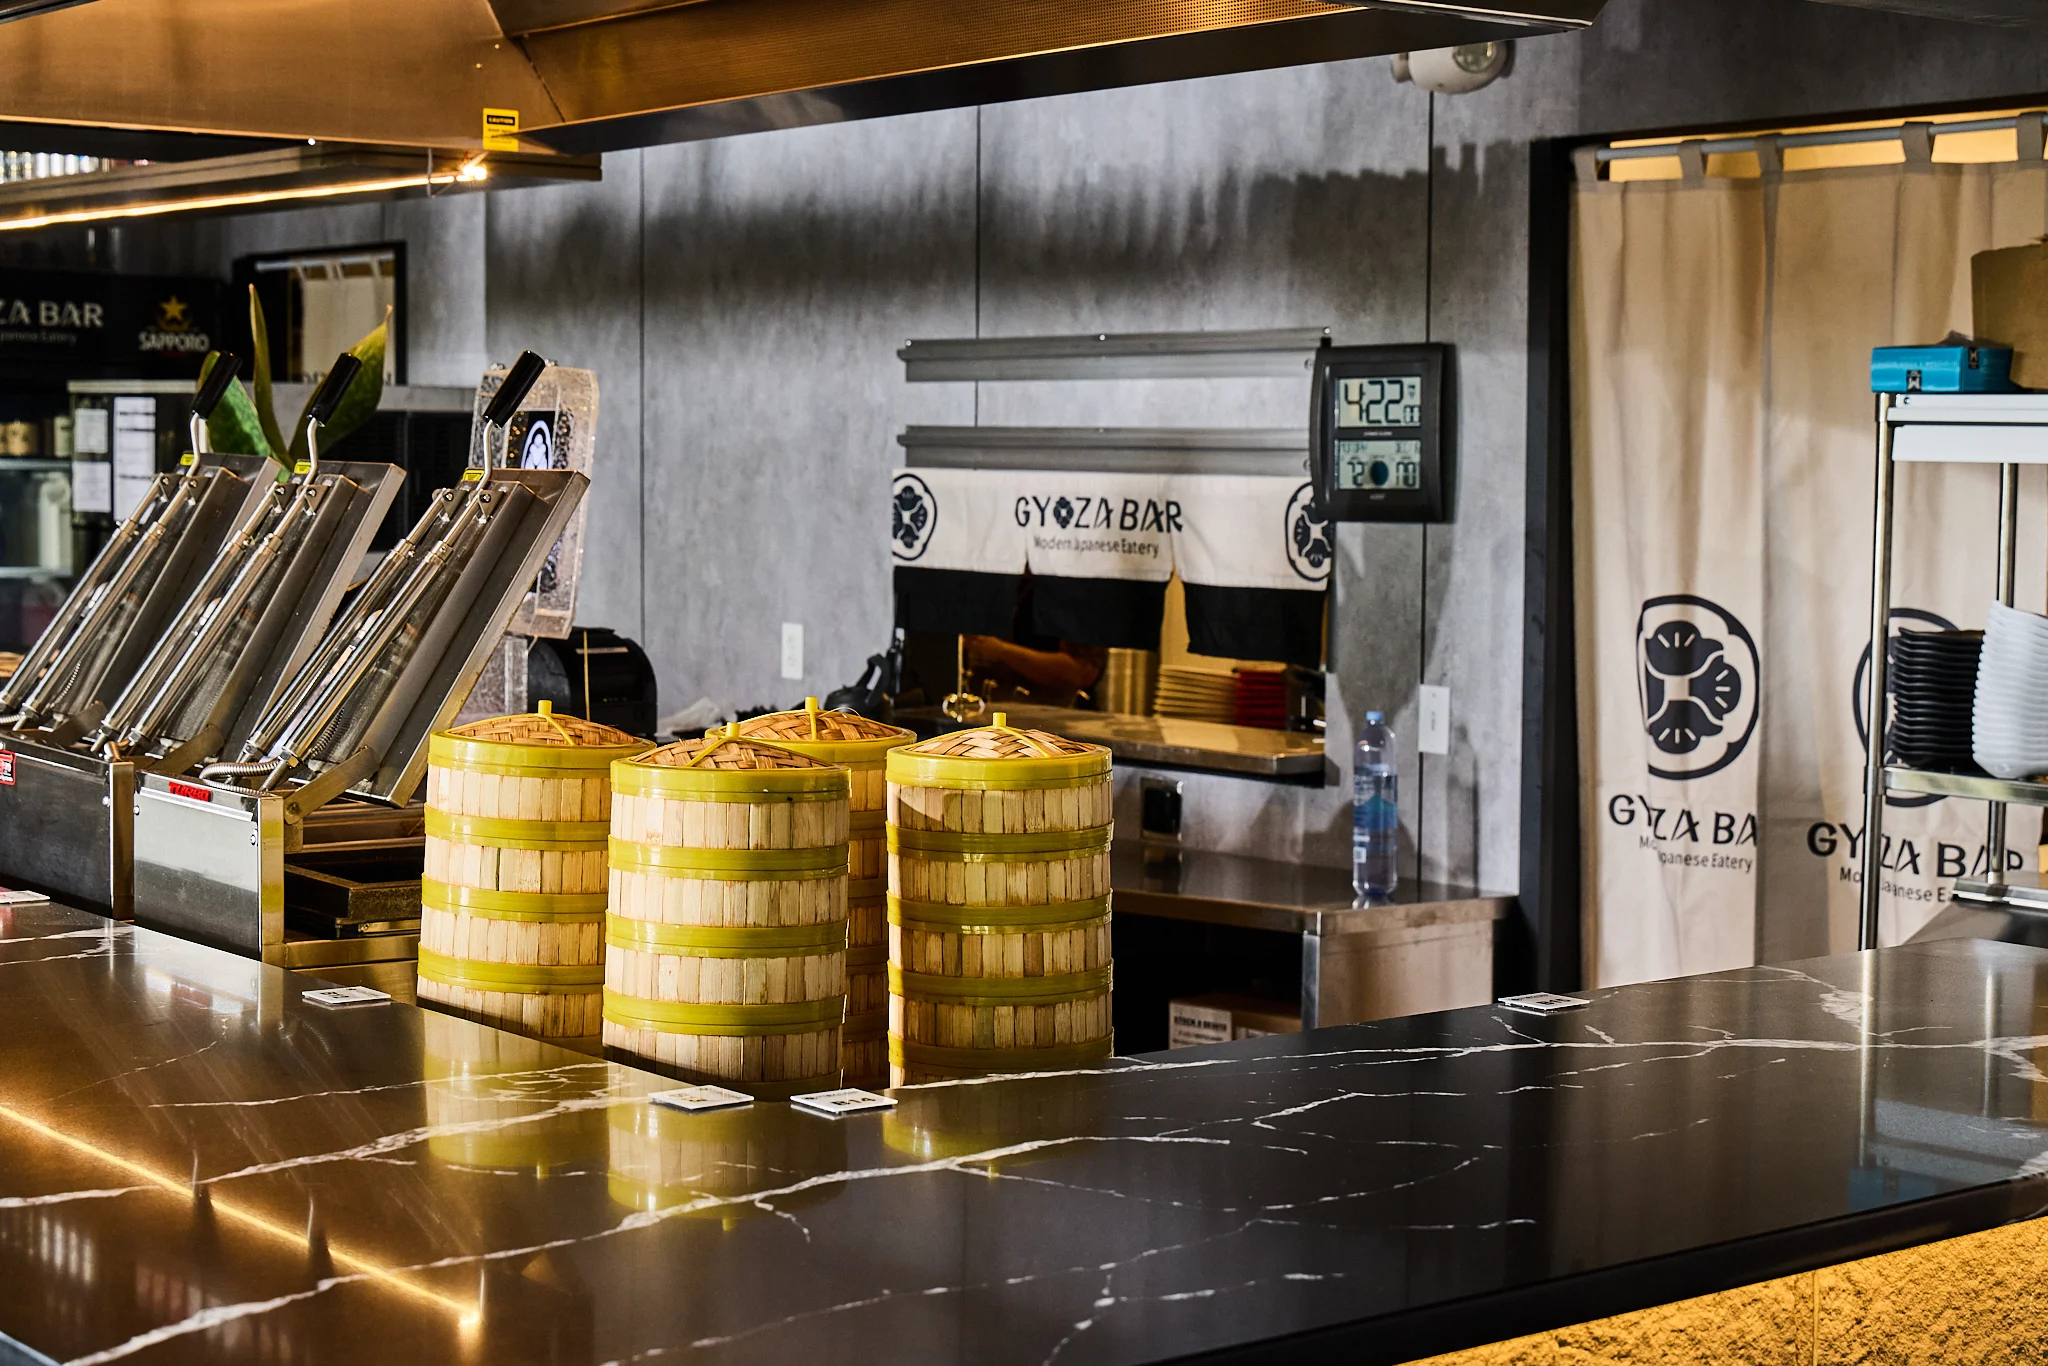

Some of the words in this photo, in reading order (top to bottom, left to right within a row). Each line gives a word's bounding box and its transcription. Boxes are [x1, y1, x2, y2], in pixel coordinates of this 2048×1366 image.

[39, 300, 103, 327] BAR
[138, 331, 210, 352] SAPPORO
[1119, 498, 1183, 533] BAR
[1121, 537, 1159, 559] Eatery
[168, 781, 211, 802] TURBO
[1609, 794, 1699, 842] GYZA
[1713, 811, 1757, 846] BA
[1807, 822, 1920, 875] GYZA
[1658, 851, 1709, 868] panese
[1711, 853, 1753, 873] Eatery
